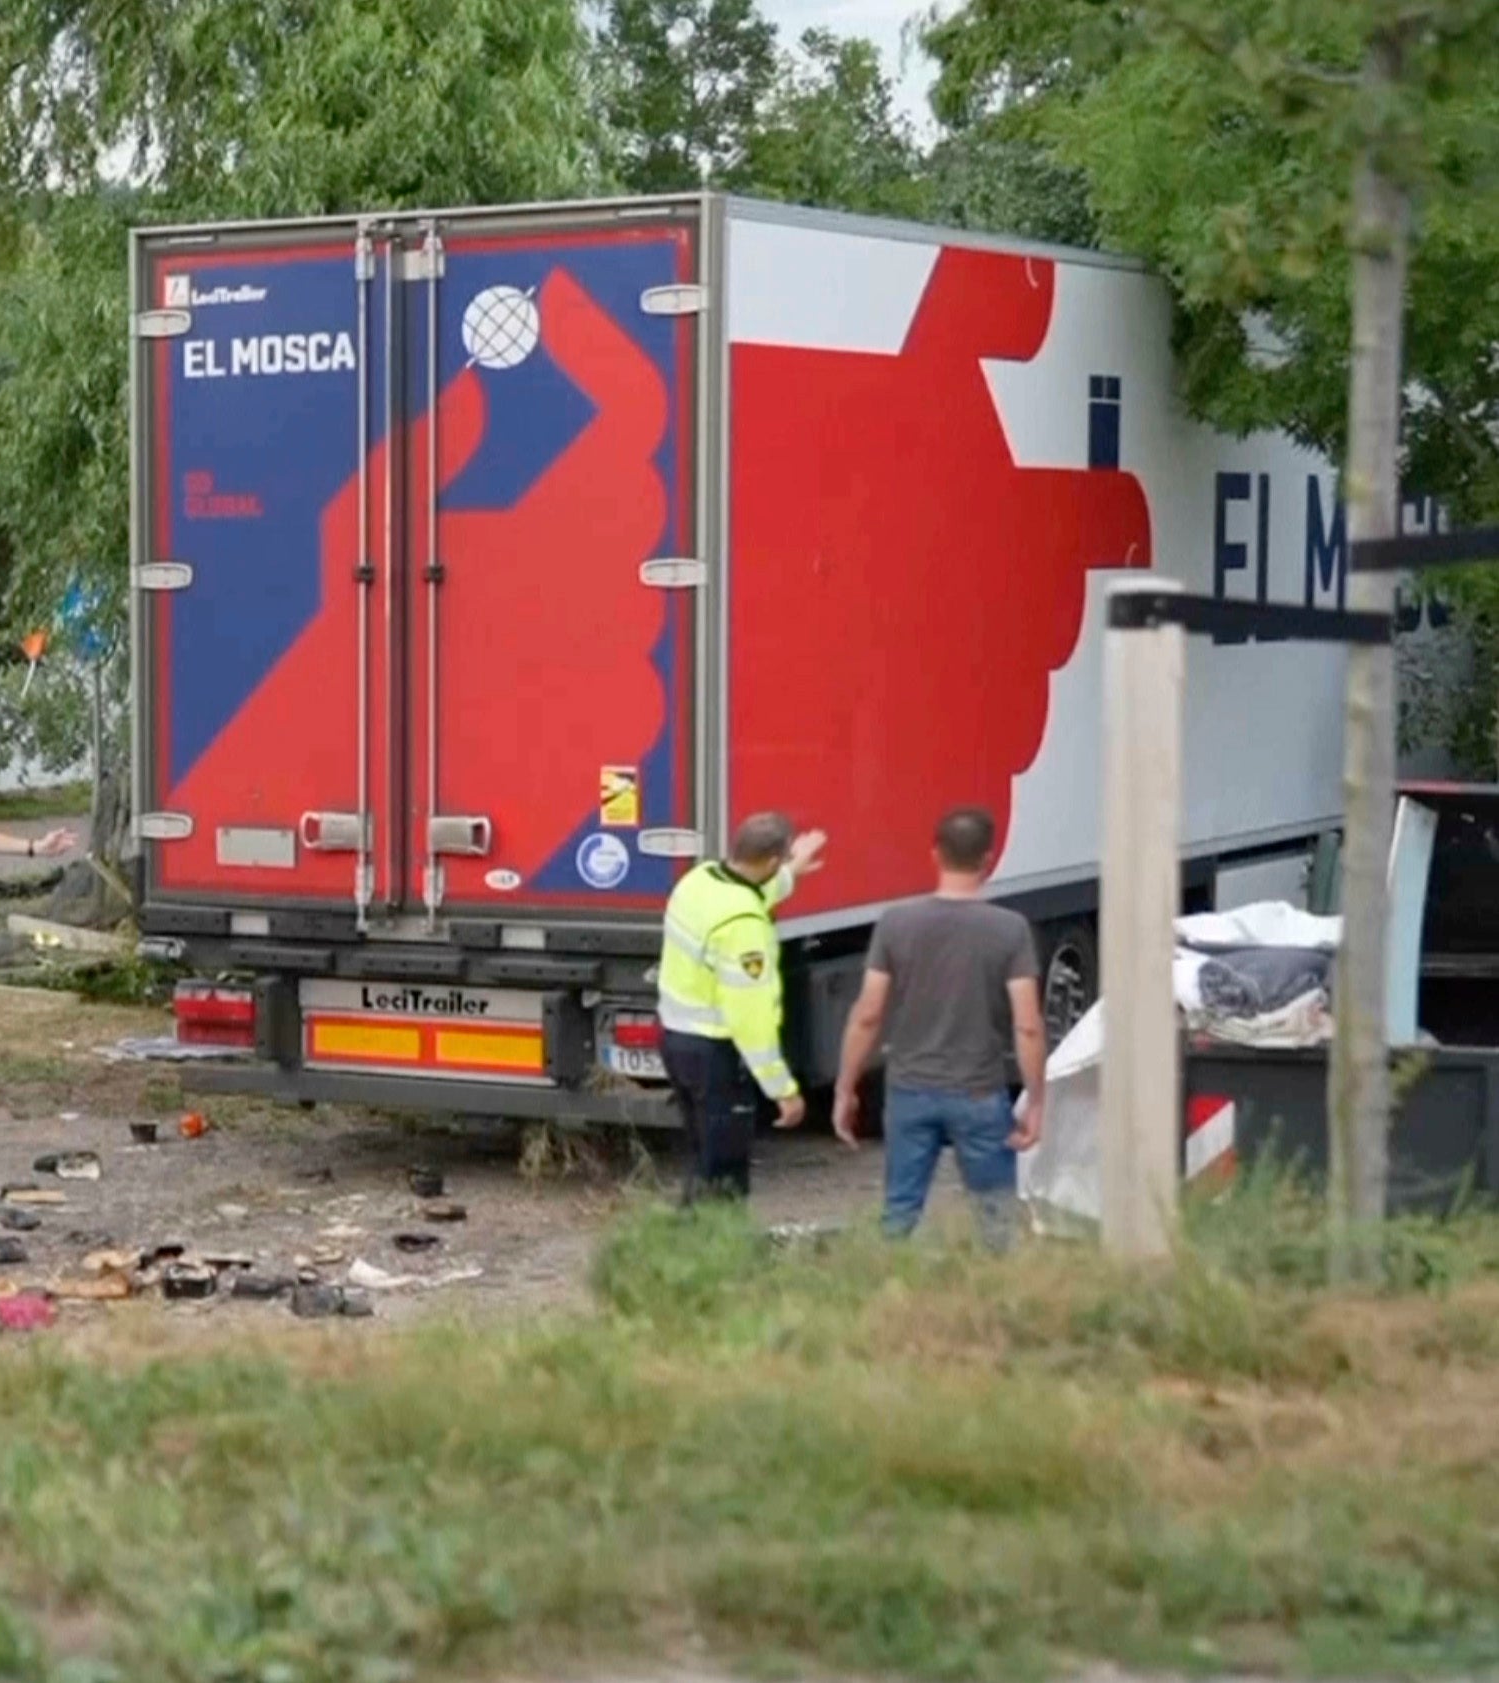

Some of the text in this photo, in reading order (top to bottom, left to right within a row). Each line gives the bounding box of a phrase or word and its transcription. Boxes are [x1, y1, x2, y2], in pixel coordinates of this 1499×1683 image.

[184, 331, 356, 379] EL MOSCA
[361, 986, 489, 1014] LeciTrailer
